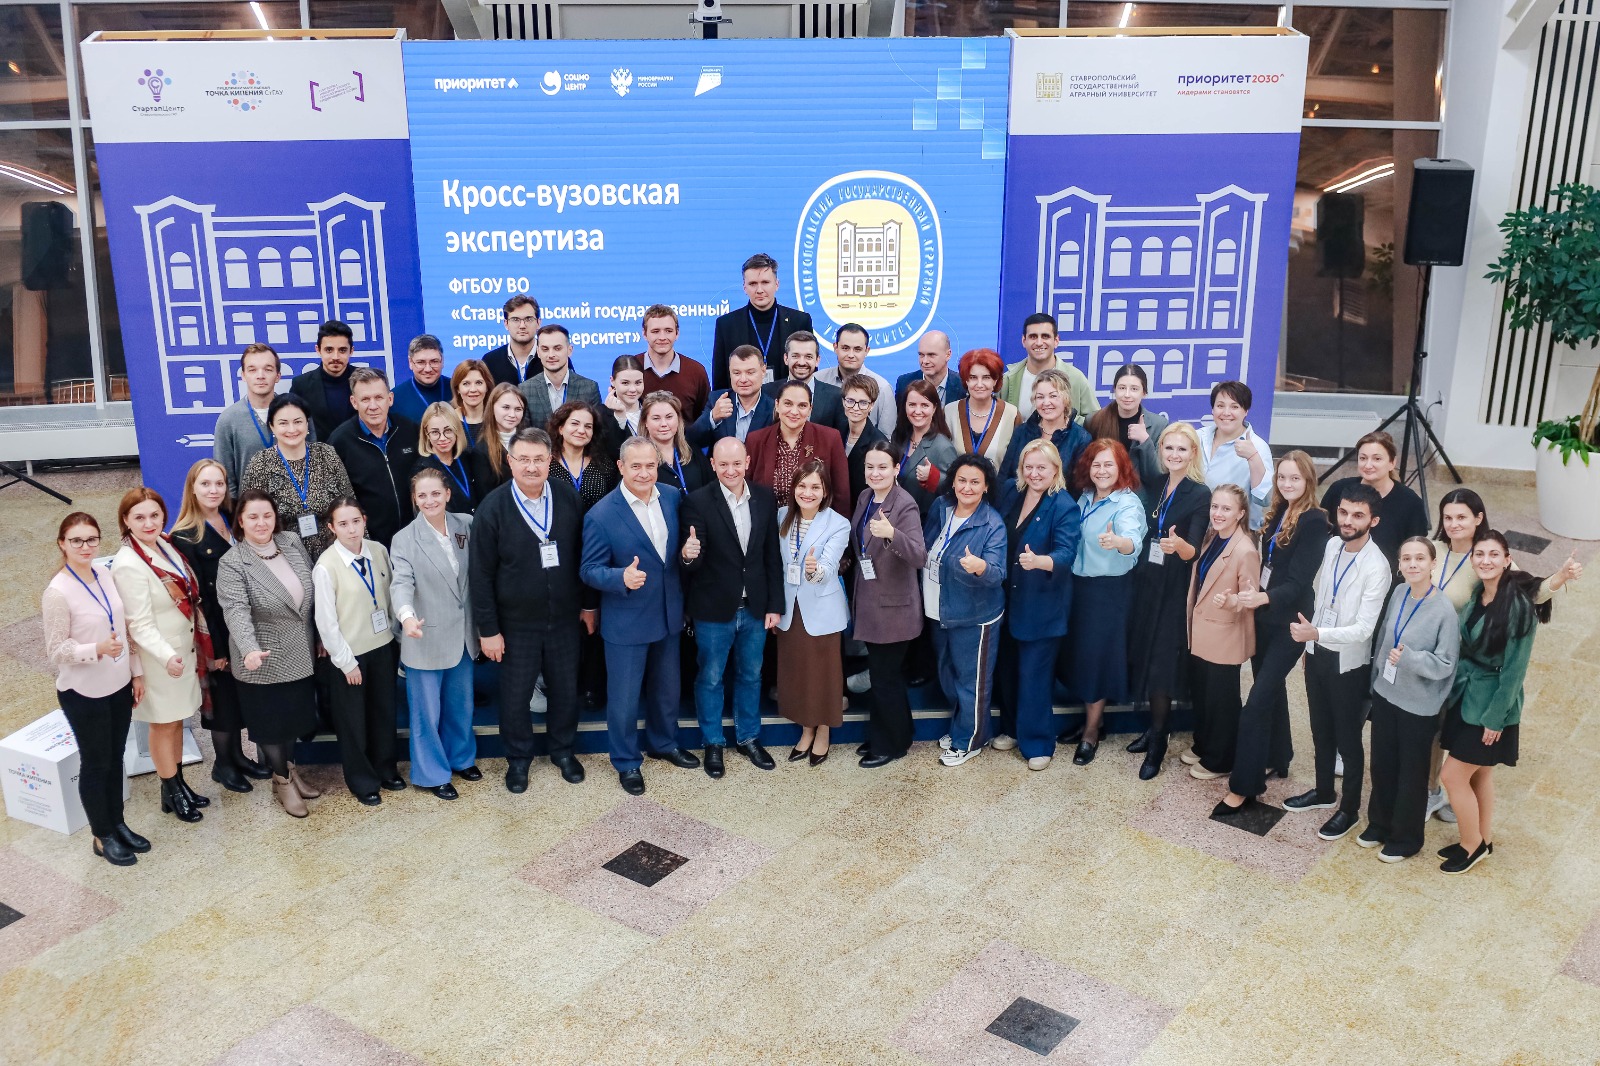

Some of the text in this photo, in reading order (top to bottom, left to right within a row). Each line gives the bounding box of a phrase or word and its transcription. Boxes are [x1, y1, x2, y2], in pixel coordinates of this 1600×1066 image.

[563, 73, 590, 82] СОЦИО
[1070, 74, 1137, 82] СТАВРОПОЛЬСКИЙ
[434, 78, 507, 93] приоритет
[564, 83, 587, 92] ЦЕНТР
[1069, 82, 1140, 90] ГОСУДАРСТВЕННЫЙ
[131, 105, 186, 114] СтартапЦентр
[442, 179, 680, 214] Кросс-вузовская
[445, 228, 604, 259] экспертиза
[448, 277, 530, 294] ФГБОУ ВО
[451, 299, 730, 324] «Ставрьский госудавенный
[858, 301, 879, 310] 1930
[452, 331, 641, 351] аграрн ерситет»
